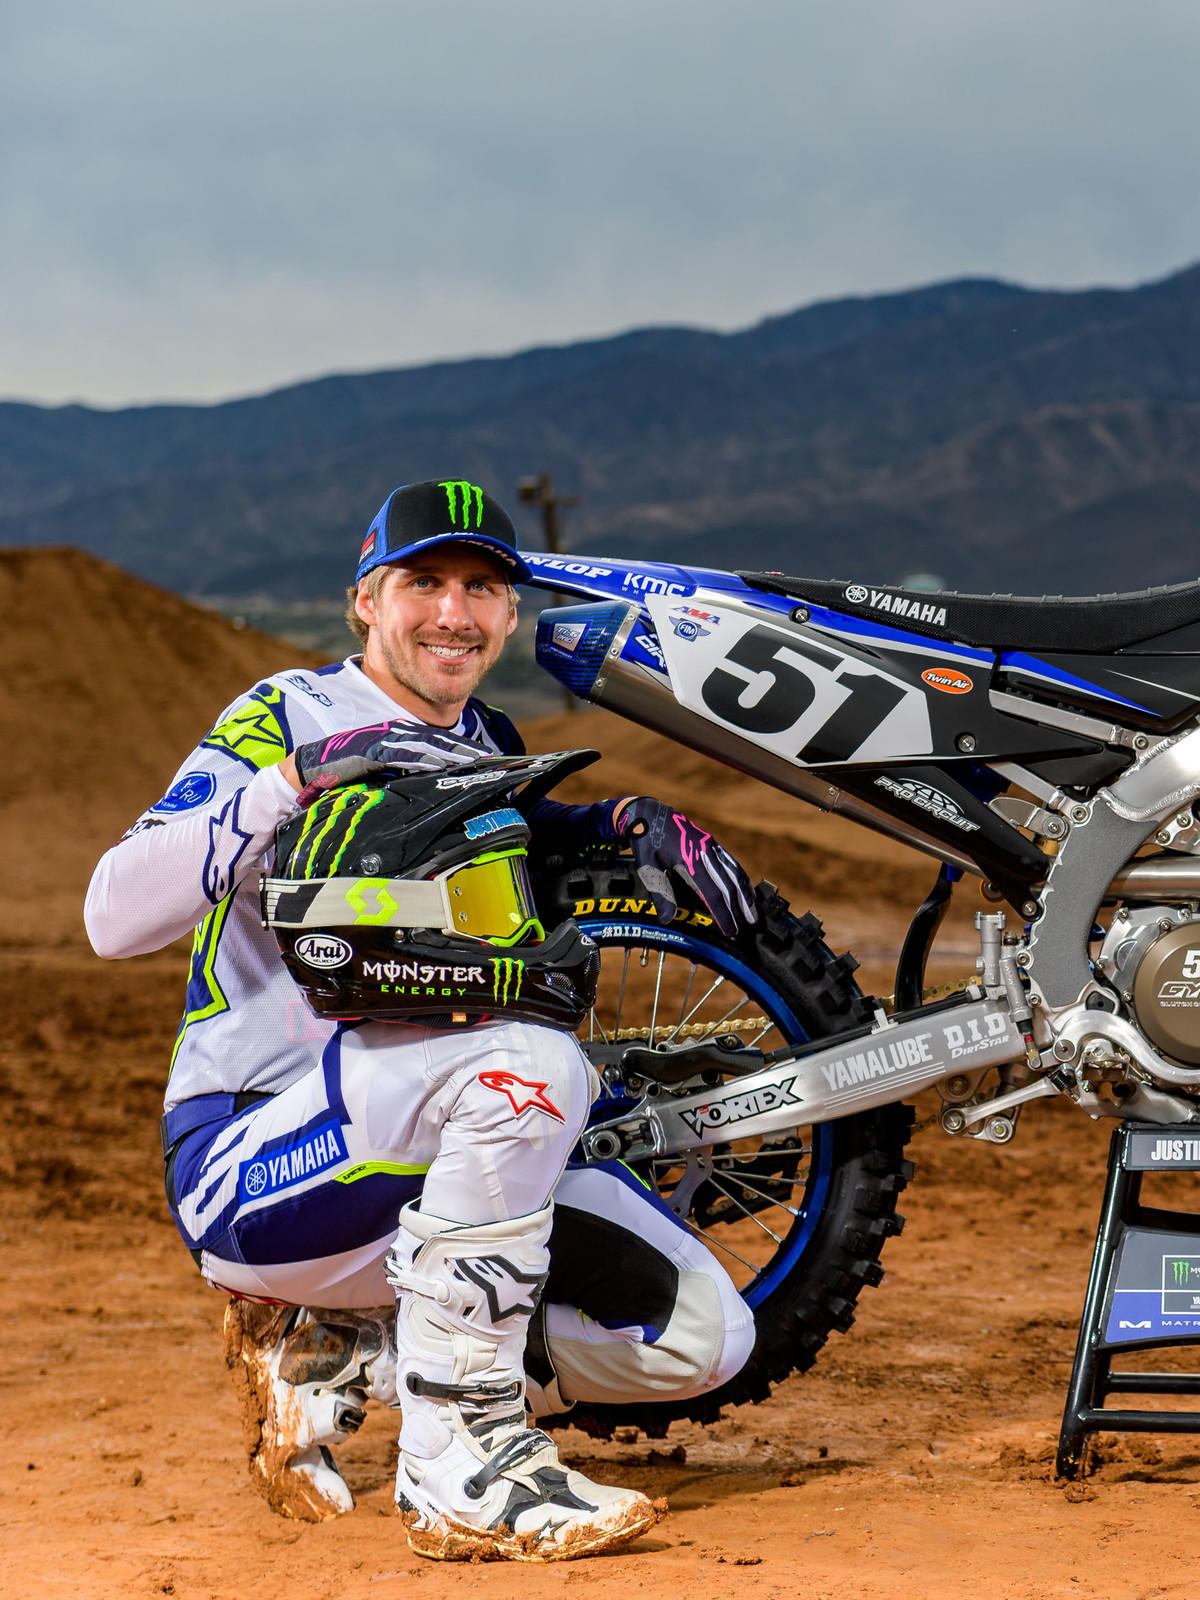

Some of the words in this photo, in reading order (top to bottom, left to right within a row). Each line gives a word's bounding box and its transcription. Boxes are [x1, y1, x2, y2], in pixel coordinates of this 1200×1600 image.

[521, 555, 613, 578] NLOP
[669, 606, 720, 625] AMA
[869, 590, 947, 626] YAMAHA
[680, 624, 695, 635] FIM
[926, 672, 951, 686] Twin
[950, 679, 970, 689] Air
[701, 623, 908, 764] 51
[874, 775, 916, 801] PRO
[911, 796, 981, 832] CIRCUIT
[301, 940, 344, 958] Arai
[362, 960, 487, 984] MONSTER
[381, 984, 467, 997] ENERGY
[820, 1034, 933, 1091] YAMALUBE
[943, 1012, 1007, 1050] D.I.D
[679, 1076, 802, 1139] VORTEX
[268, 1129, 341, 1187] YAMAHA
